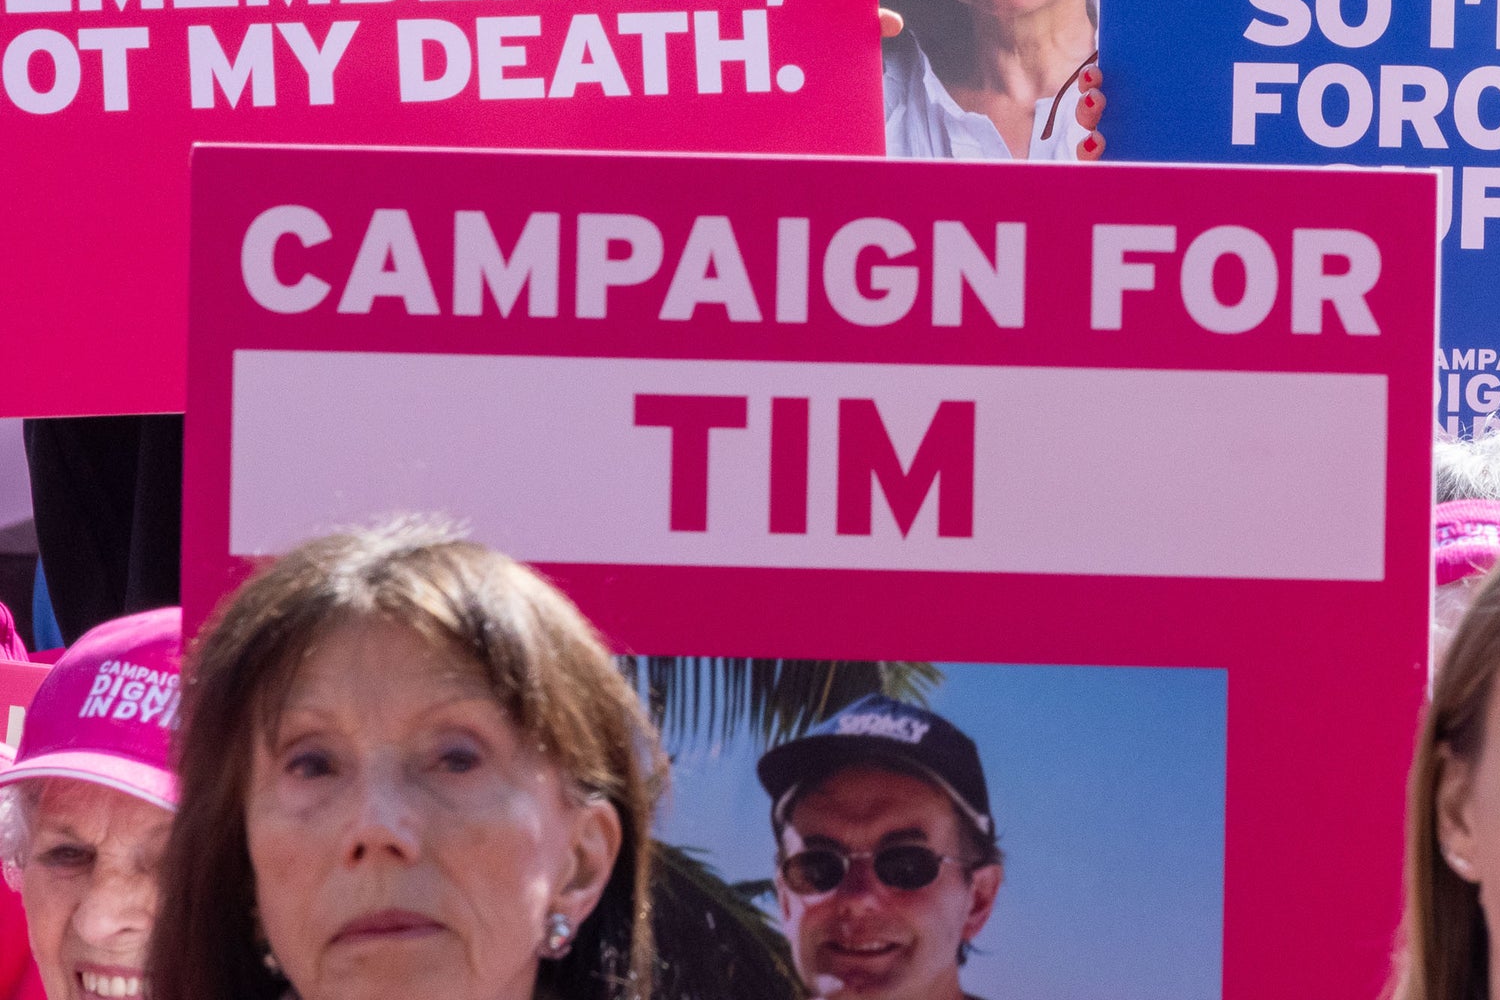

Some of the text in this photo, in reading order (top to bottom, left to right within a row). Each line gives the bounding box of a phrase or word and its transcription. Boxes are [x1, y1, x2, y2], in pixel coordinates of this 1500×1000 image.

[2, 9, 806, 115] OT MY DEATH.
[239, 202, 1383, 336] CAMPAIGN FOR
[633, 392, 978, 539] TIM
[78, 696, 114, 718] IN
[99, 660, 180, 688] CAMPAIG
